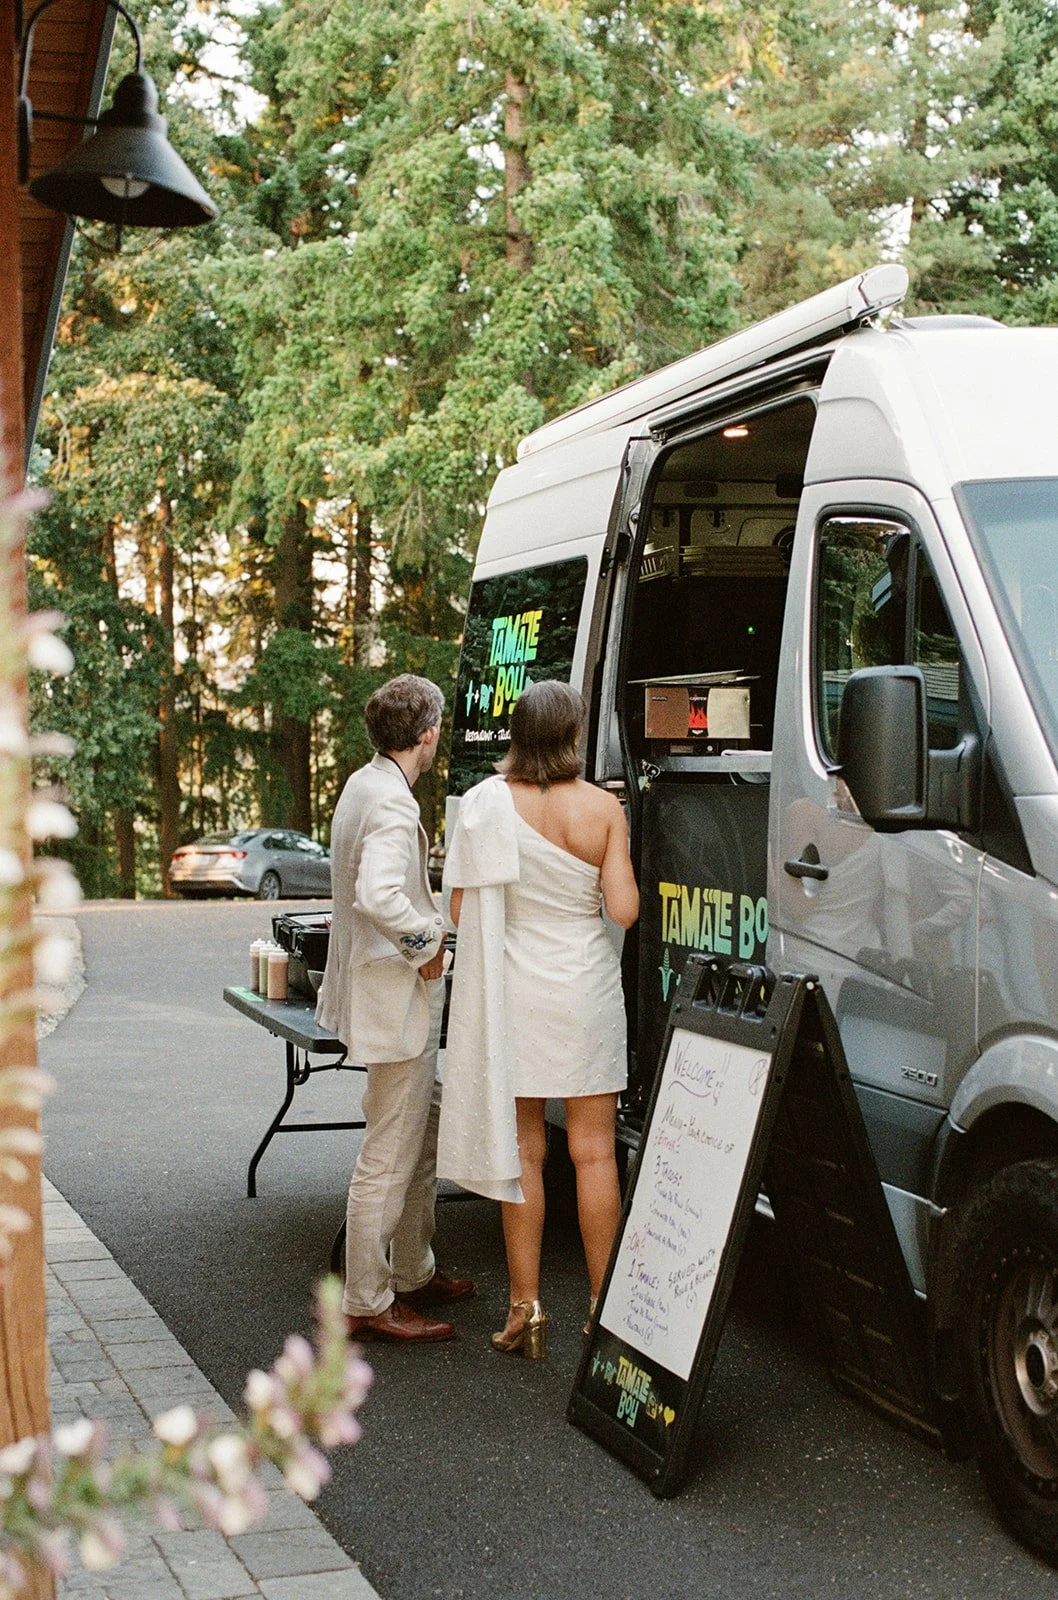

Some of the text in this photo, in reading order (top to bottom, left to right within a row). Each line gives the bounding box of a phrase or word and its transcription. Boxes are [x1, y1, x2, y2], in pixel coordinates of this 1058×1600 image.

[490, 610, 543, 667] TAMALE
[658, 881, 769, 960] TAMALE BO
[900, 1065, 939, 1087] 2500
[615, 1355, 652, 1404] TAMALE
[616, 1390, 640, 1428] BOY
